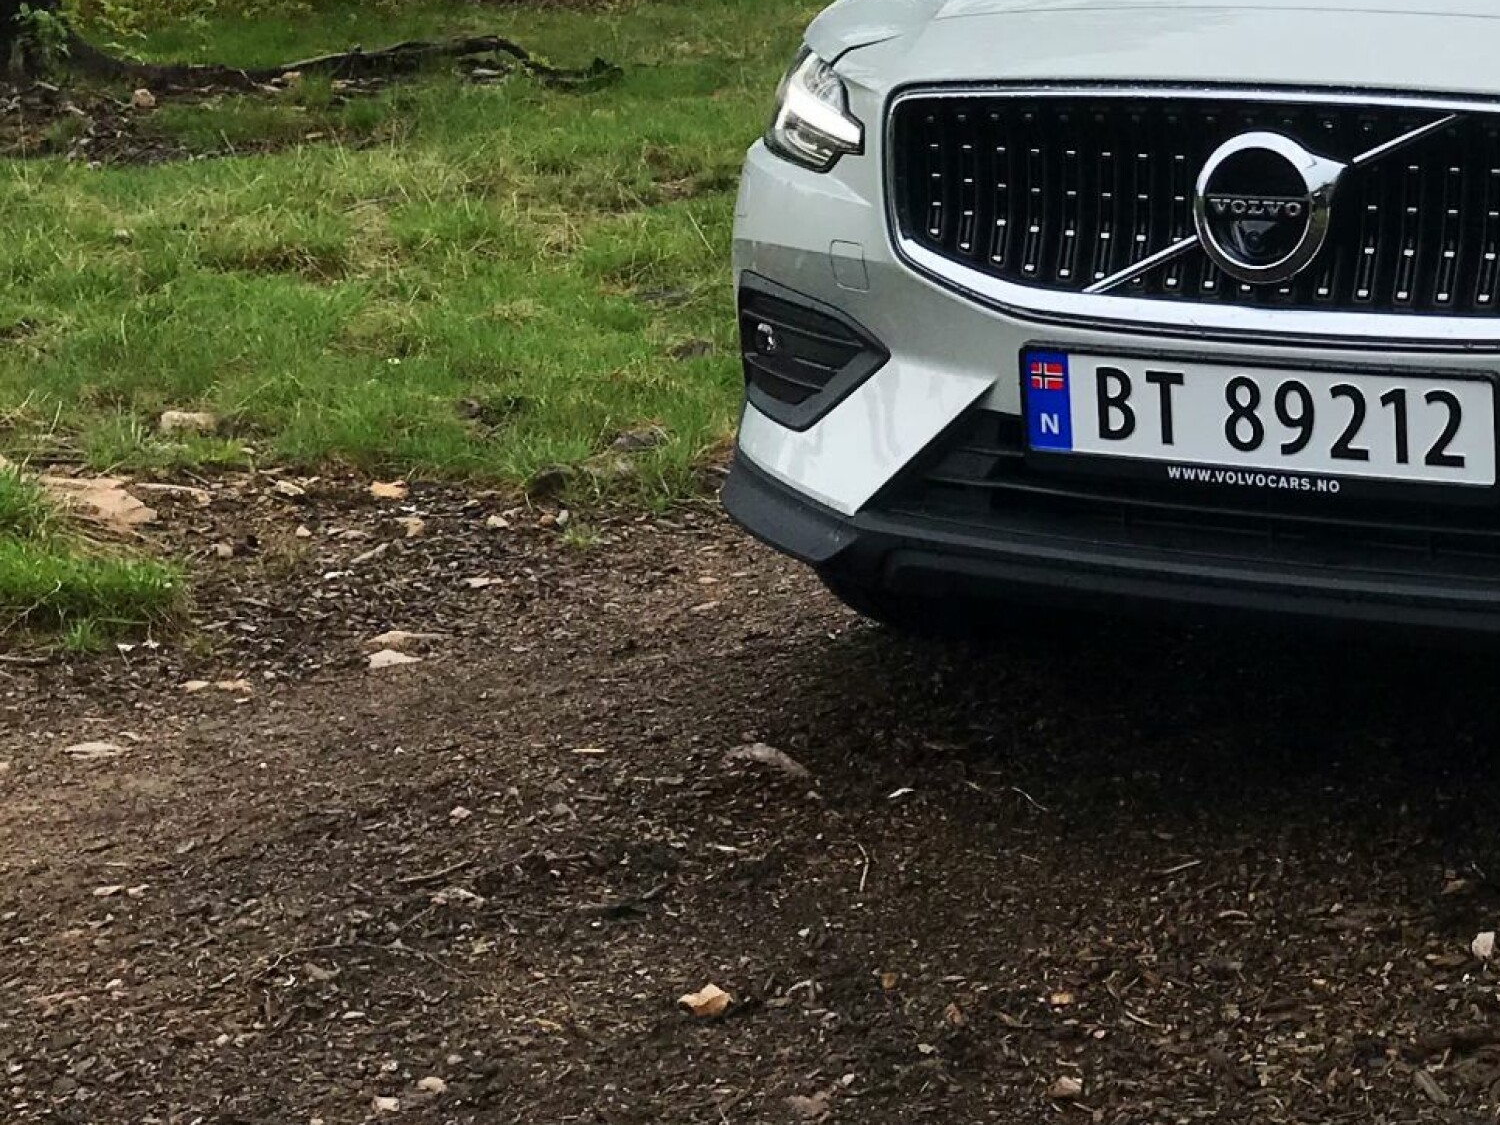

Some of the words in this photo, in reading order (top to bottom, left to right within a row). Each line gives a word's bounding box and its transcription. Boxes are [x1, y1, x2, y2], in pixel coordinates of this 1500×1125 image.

[1210, 198, 1301, 216] VOLVO
[1040, 413, 1060, 434] N
[1096, 366, 1184, 445] BT
[1225, 376, 1466, 468] 89212
[1167, 465, 1341, 493] WWW.VOLVOCARS.NO
